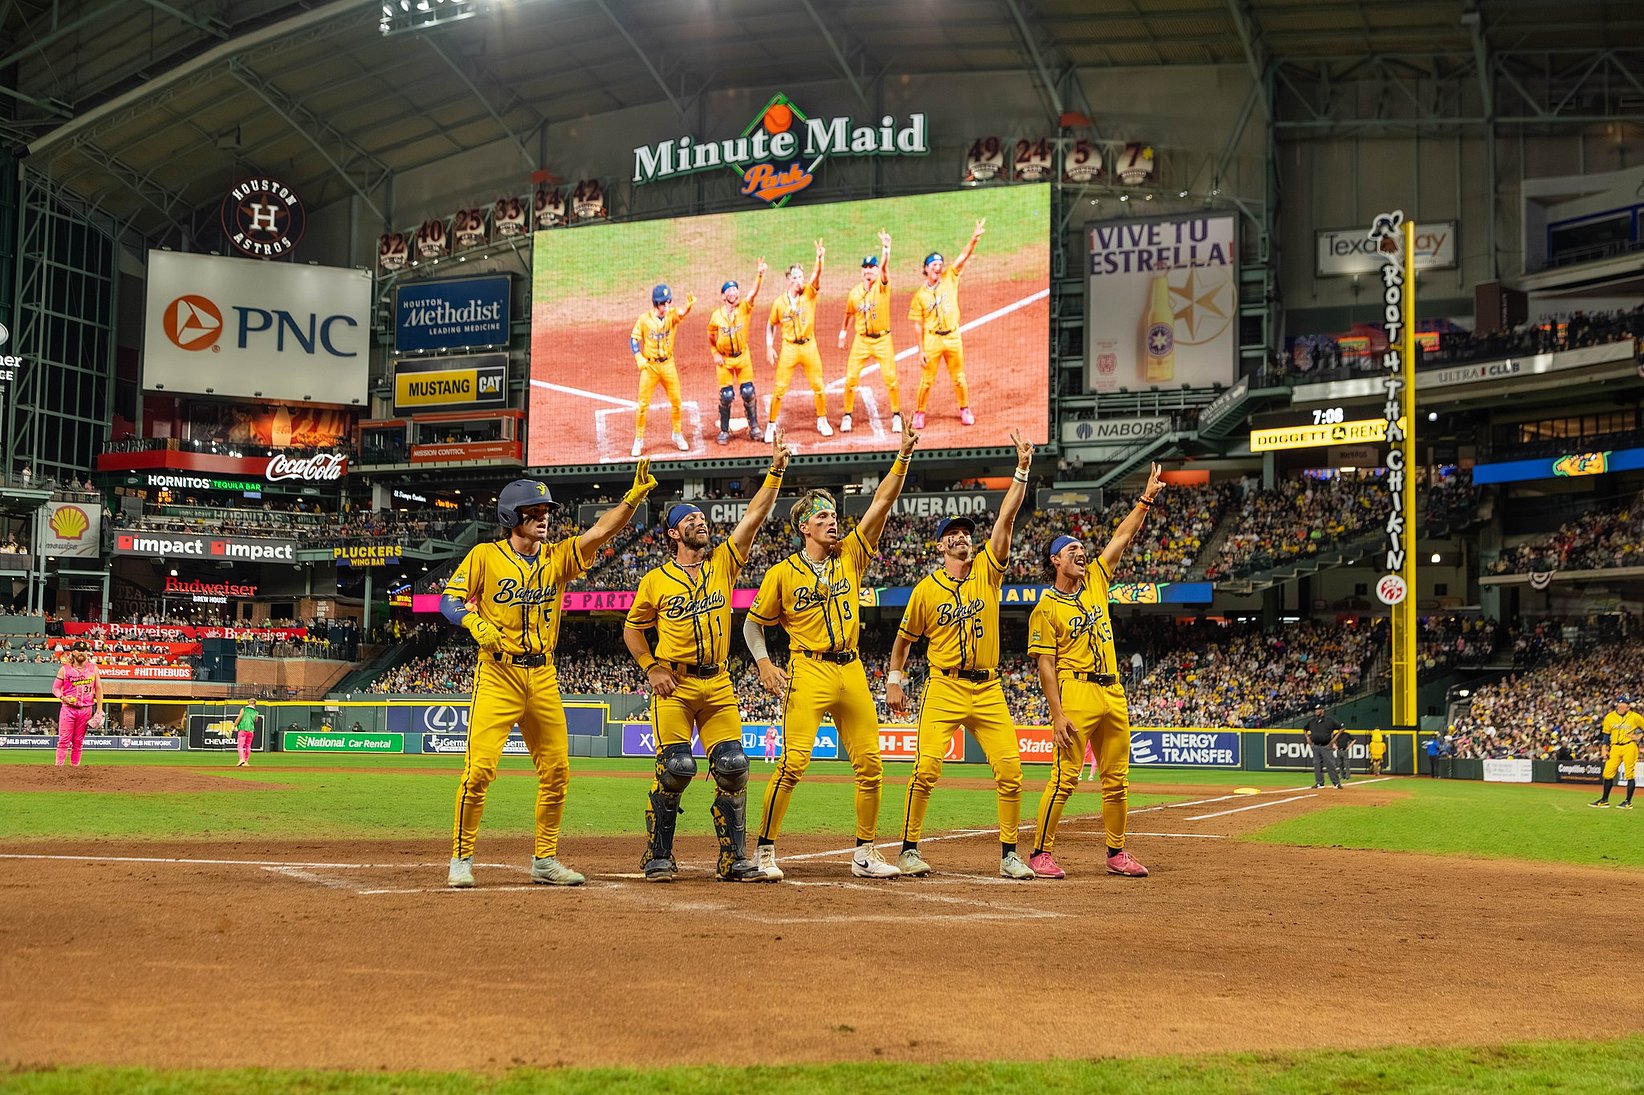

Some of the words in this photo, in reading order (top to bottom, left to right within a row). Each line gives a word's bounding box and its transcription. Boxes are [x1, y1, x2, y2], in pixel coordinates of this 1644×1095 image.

[633, 128, 795, 183] Minute
[803, 113, 928, 155] Maid
[968, 136, 1000, 162] 49
[1016, 137, 1051, 163] 24
[1074, 140, 1090, 164] 5
[1126, 142, 1142, 168] 7
[573, 179, 600, 202] 42
[741, 163, 808, 197] Park
[233, 179, 297, 207] HOUSTON
[535, 188, 560, 211] 34
[250, 203, 280, 232] H
[455, 209, 481, 231] 25
[495, 198, 520, 221] 33
[418, 219, 444, 243] 40
[1169, 218, 1208, 243] TU
[233, 231, 293, 256] ASTROS
[380, 233, 405, 255] 32
[1415, 232, 1447, 256] ay
[1091, 241, 1234, 276] ESTRELLA!
[403, 298, 443, 309] HOUSTON
[403, 299, 501, 328] Methodist
[1383, 263, 1403, 344] ROOT
[232, 305, 358, 358] PNC
[429, 325, 461, 336] LEADING
[464, 322, 500, 334] MEDICINE
[1383, 351, 1401, 373] 4
[409, 378, 470, 398] MUSTANG
[478, 374, 502, 394] CAT
[1383, 379, 1403, 442] THA
[1097, 421, 1165, 437] NABORS
[1258, 430, 1327, 446] DOGGETT
[413, 448, 438, 458] MISSION
[438, 448, 466, 457] CONTROL
[148, 474, 210, 490] HORNITOS
[213, 480, 245, 490] TEQUILA
[245, 483, 261, 491] BAR
[1385, 449, 1404, 571] CHIKIN
[133, 534, 203, 555] impact
[225, 539, 293, 560] impact
[333, 545, 403, 558] PLUCKERS
[350, 558, 370, 566] WING
[371, 558, 385, 566] BAR
[164, 576, 258, 597] Budweiser
[209, 596, 227, 605] HOUSE
[98, 667, 131, 677] weiser
[134, 667, 191, 678] #HITTHEBUDS
[6, 738, 19, 746] MLB
[20, 738, 50, 746] NETWORK
[131, 739, 143, 747] MLB
[144, 739, 172, 747] NETWORK
[204, 738, 238, 746] CHEVROL
[307, 737, 345, 748] National
[348, 739, 363, 748] Car
[364, 739, 391, 749] Rental
[1018, 738, 1054, 753] State
[1162, 733, 1219, 749] ENERGY
[1162, 748, 1234, 764] TRANSFER
